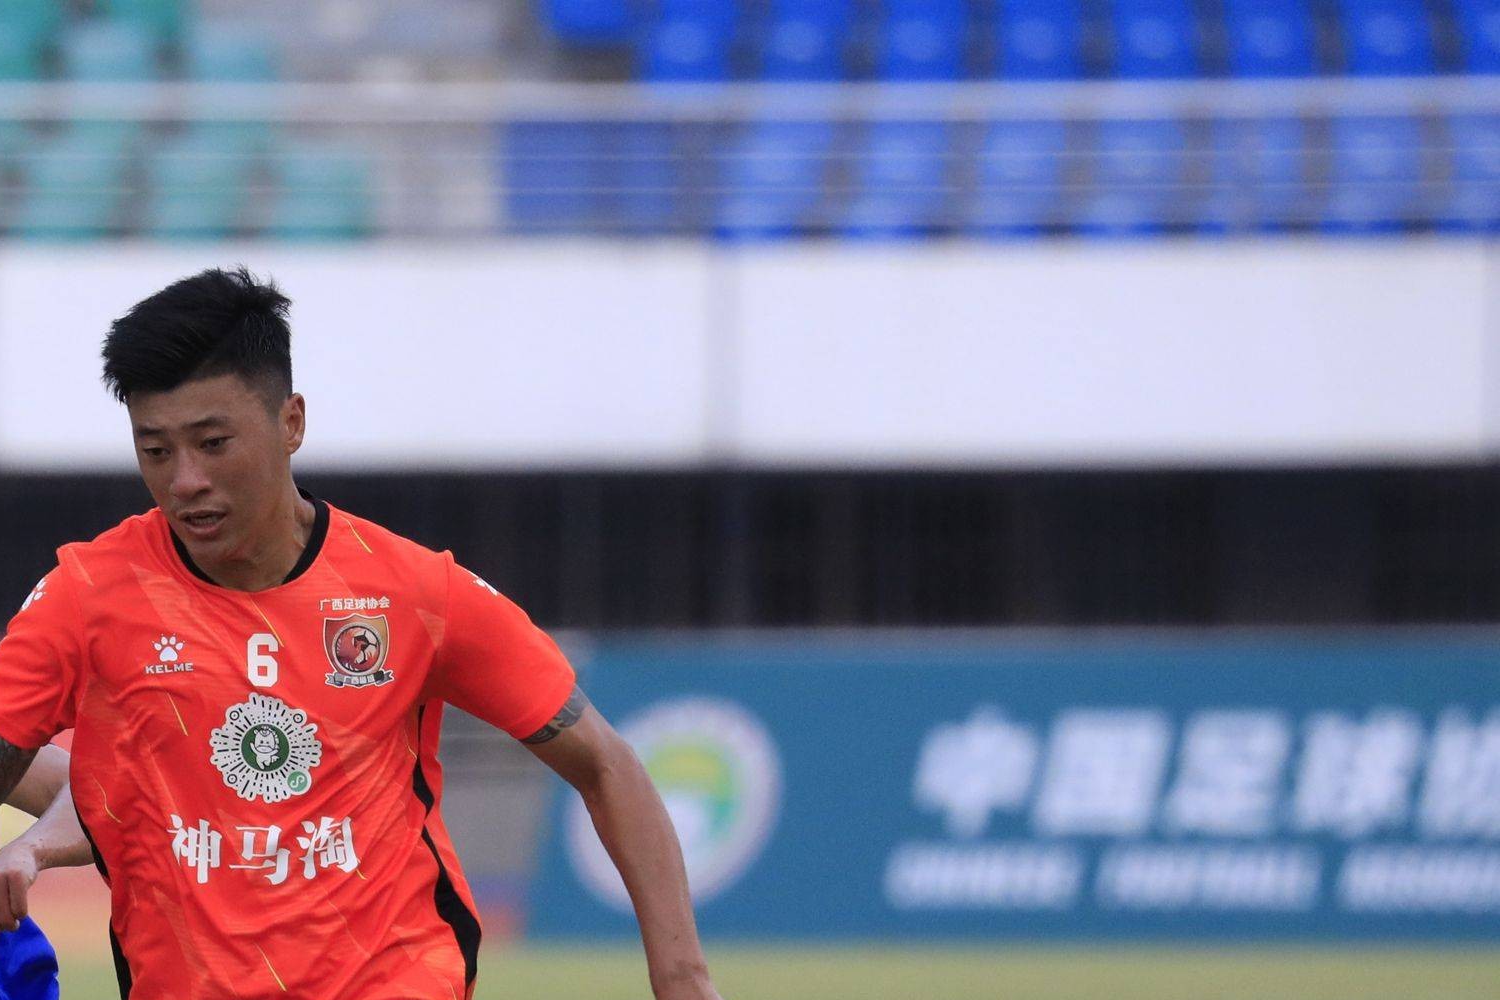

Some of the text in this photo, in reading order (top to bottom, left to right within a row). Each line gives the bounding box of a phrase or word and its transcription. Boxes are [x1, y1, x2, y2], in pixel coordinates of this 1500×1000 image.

[320, 596, 391, 611] 广西足球协会
[145, 662, 194, 674] KELME
[246, 633, 279, 688] 6
[167, 813, 360, 885] 神马淘
